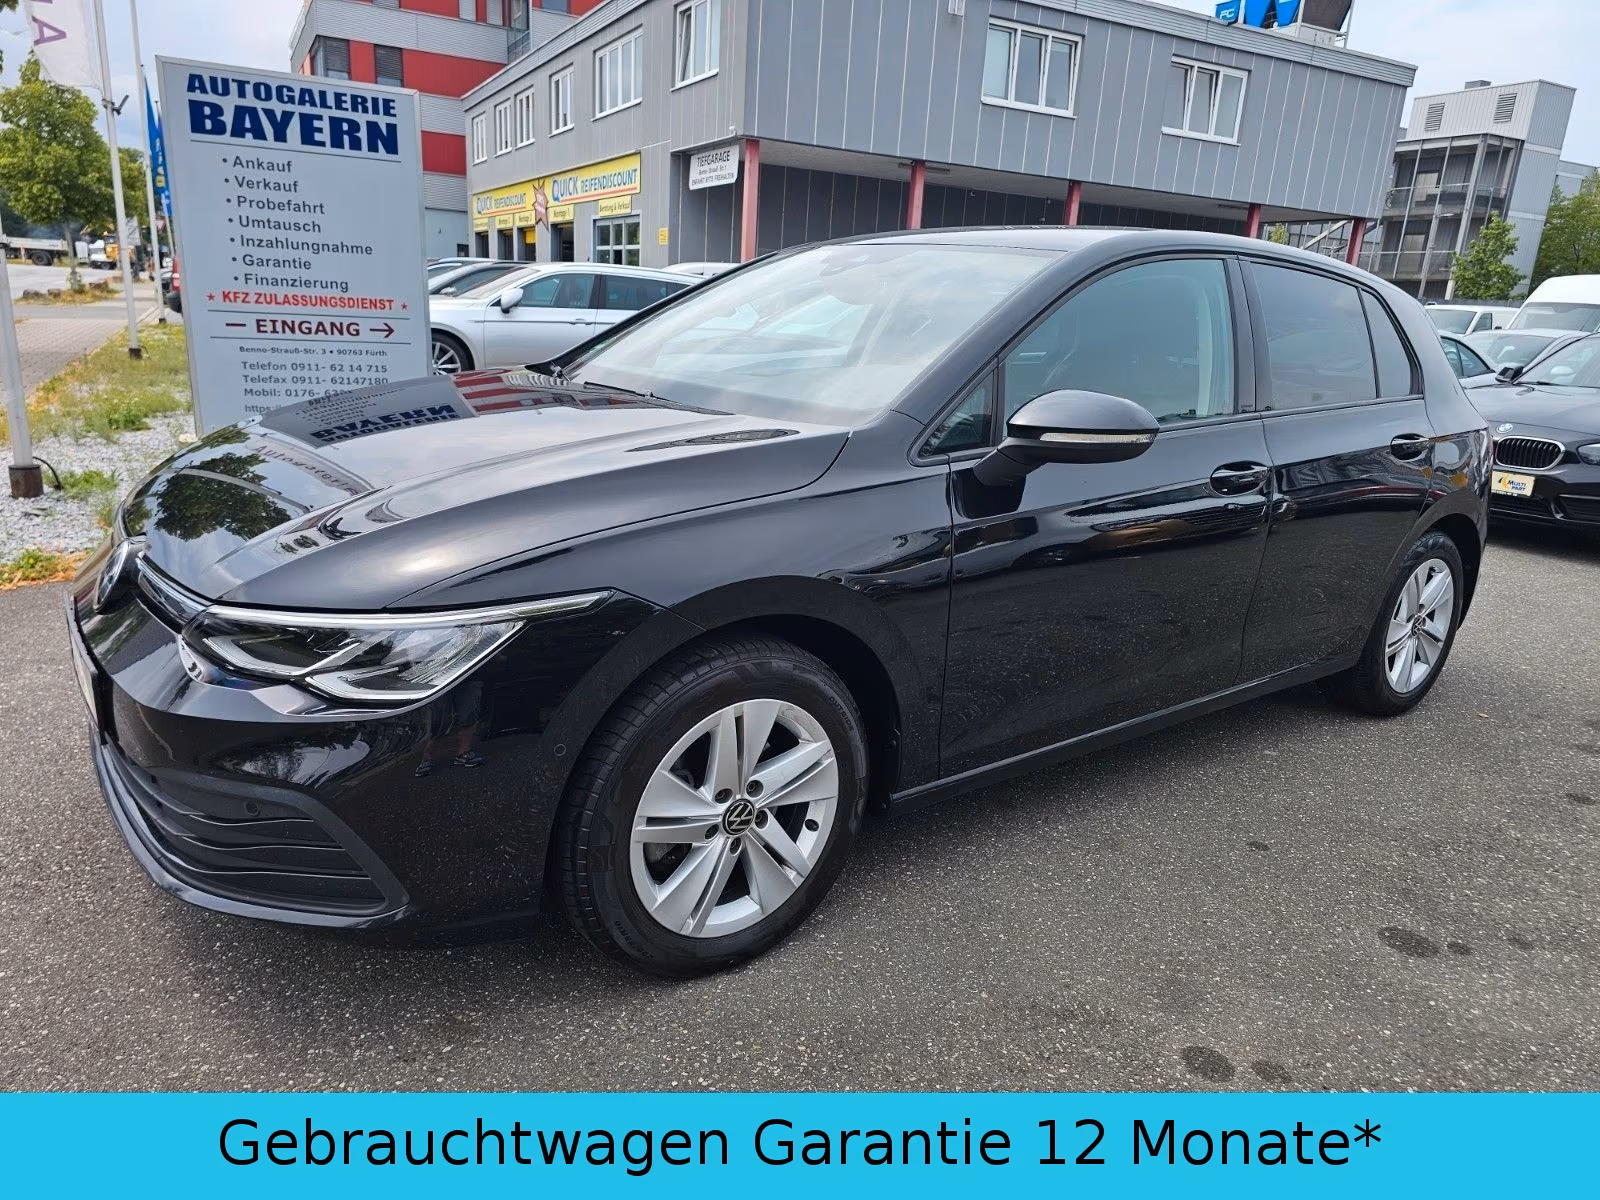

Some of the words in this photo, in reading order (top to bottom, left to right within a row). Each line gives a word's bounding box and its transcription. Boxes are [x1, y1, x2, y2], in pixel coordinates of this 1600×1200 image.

[187, 73, 397, 118] AUTOGALERIE
[188, 98, 400, 156] BAYERN
[233, 155, 293, 173] Ankauf
[697, 150, 731, 168] TIEFGARAGE
[234, 175, 299, 193] Verkauf
[551, 175, 579, 203] QUICK
[580, 167, 638, 194] REIFENDISCOUNT
[237, 195, 325, 215] Probefahrt
[239, 215, 322, 233] Umtausch
[240, 234, 373, 255] Inzahlungnahme
[242, 253, 312, 270] Garantie
[244, 273, 349, 293] Finanzierung
[222, 290, 250, 304] KFZ
[254, 292, 394, 311] ZULASSUNGSDIENST
[255, 318, 361, 337] EINGANG
[239, 345, 319, 356] Benno-Strauß-Str.
[365, 348, 388, 357] Fürth
[241, 361, 287, 372] Telefon
[291, 362, 326, 372] 0911-
[329, 363, 345, 373] 62
[348, 364, 363, 373] 14
[366, 364, 388, 373] 715
[242, 374, 288, 385] Telefax
[291, 375, 326, 385] 0911-
[244, 387, 281, 397] Mobil:
[284, 388, 321, 398] 0176-
